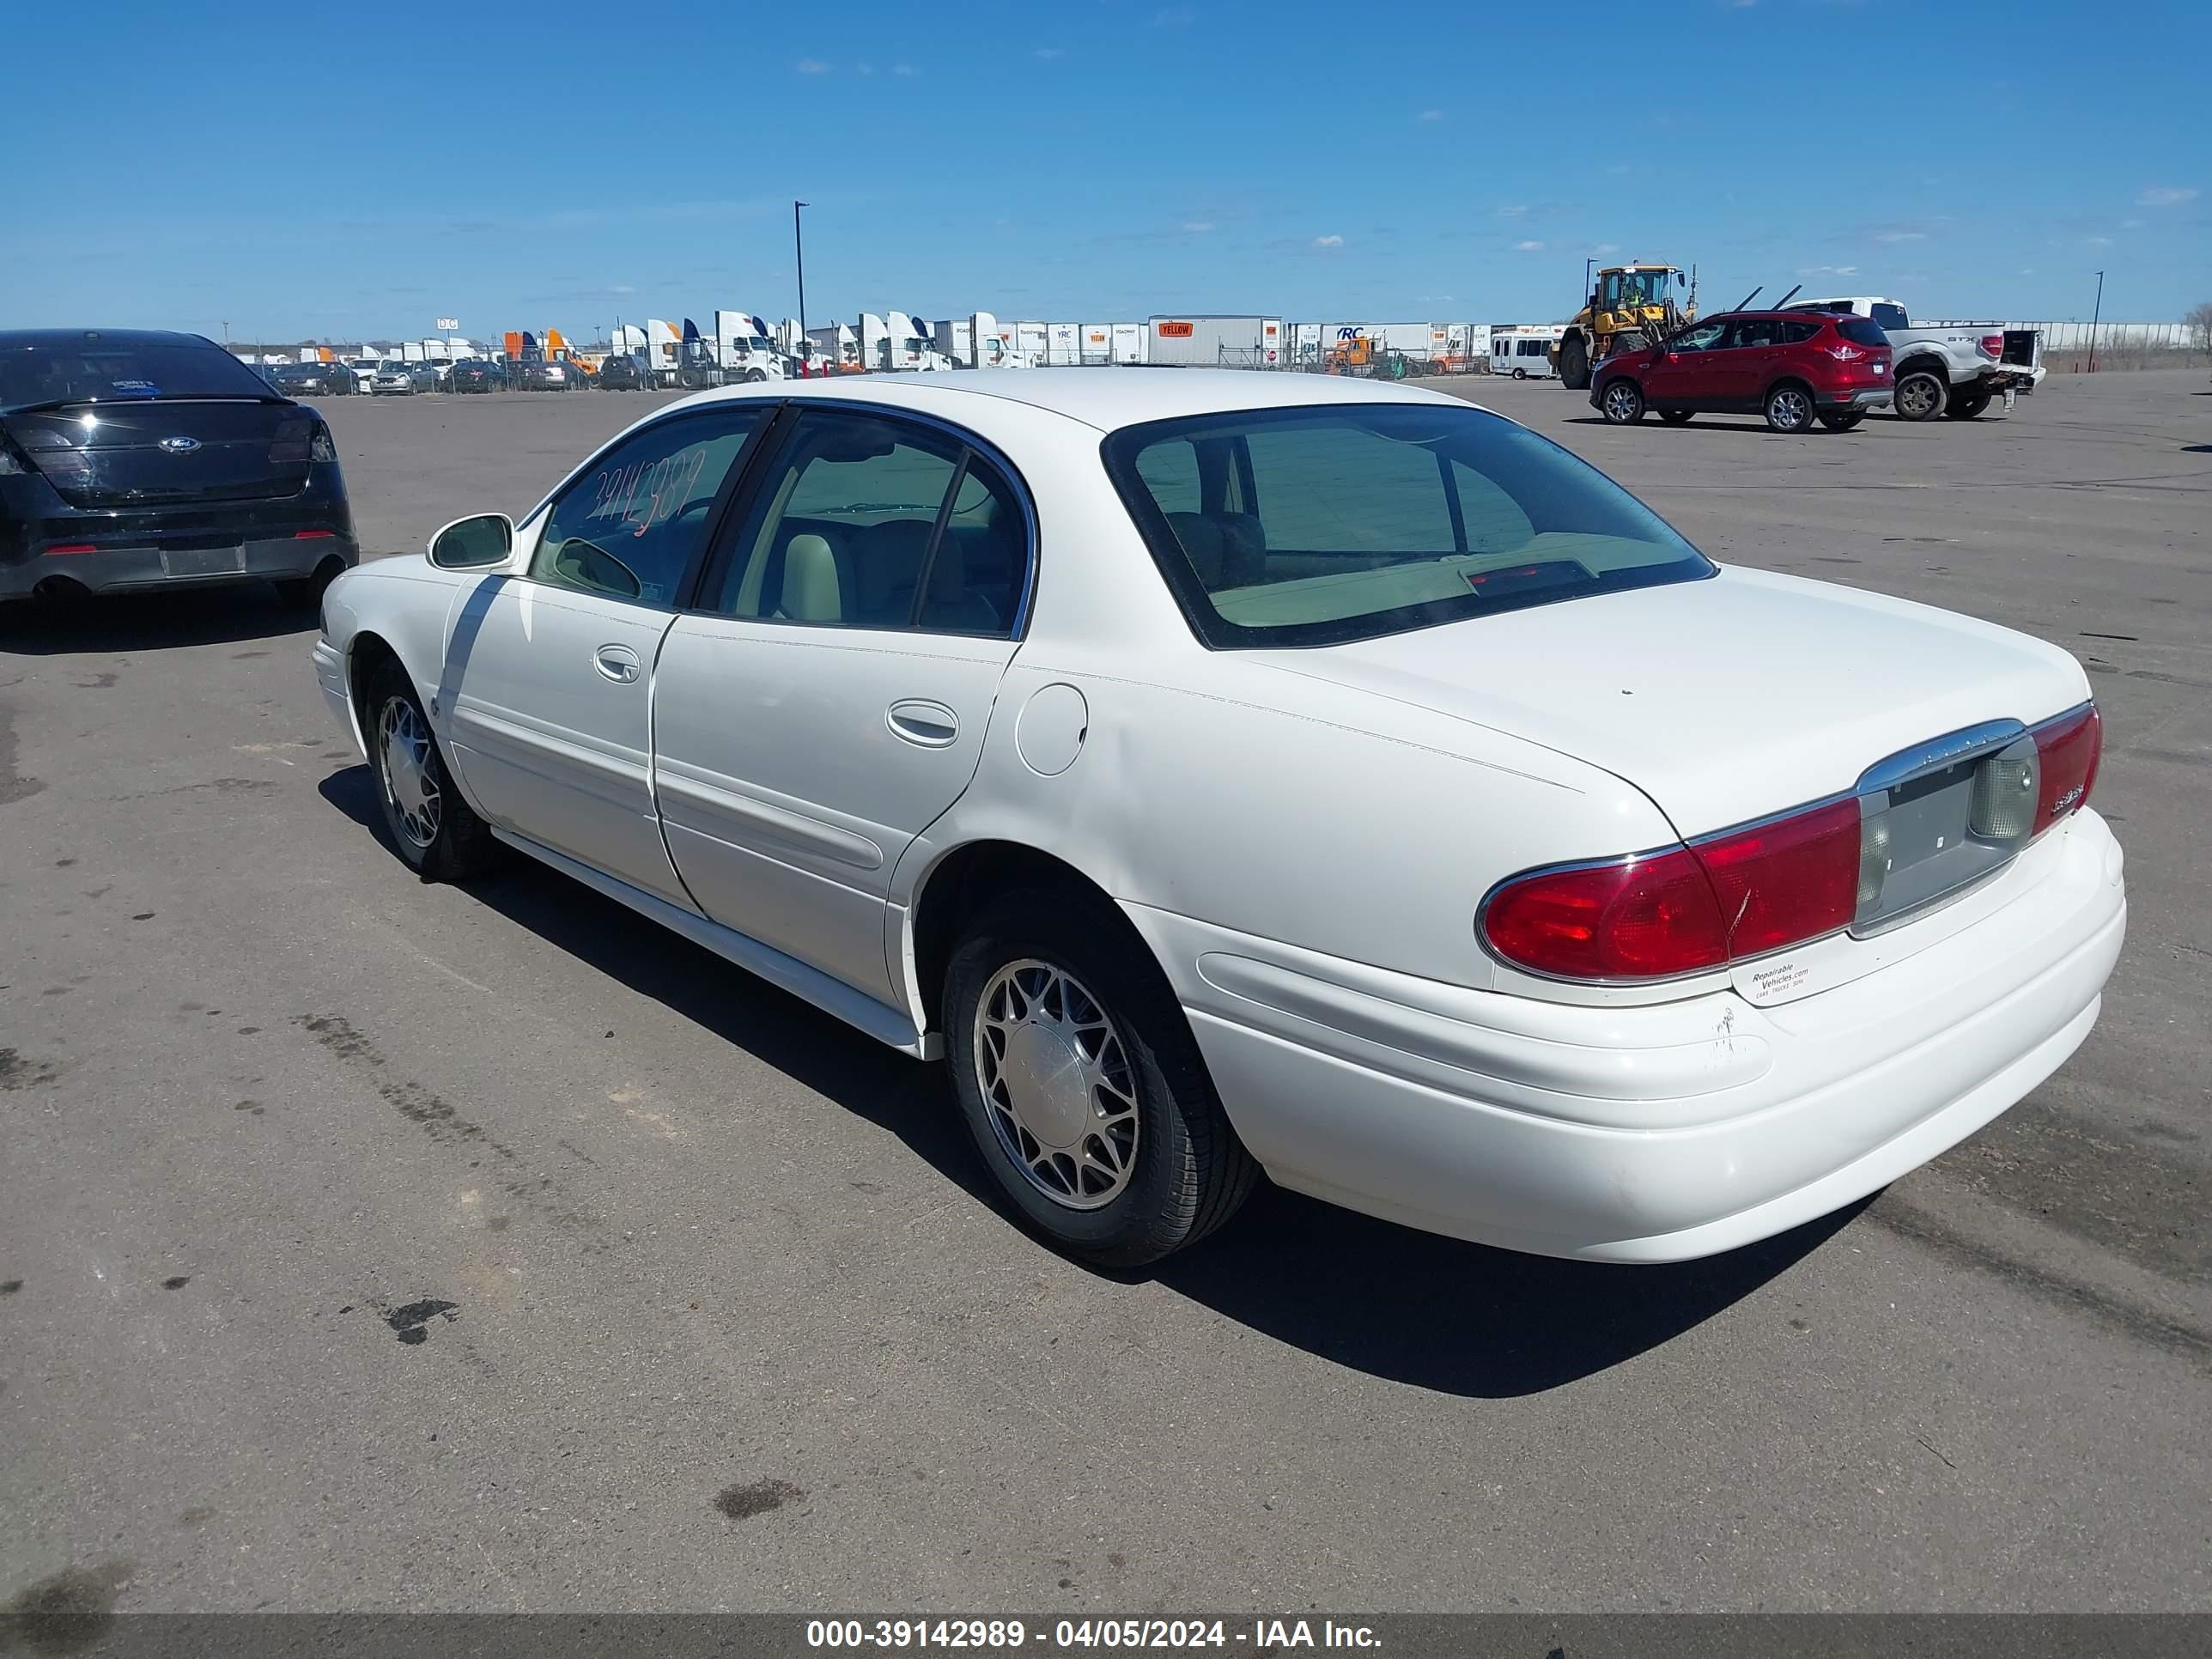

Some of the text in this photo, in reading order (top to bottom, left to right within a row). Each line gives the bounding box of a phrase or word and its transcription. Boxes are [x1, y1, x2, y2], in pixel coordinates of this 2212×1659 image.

[1163, 325, 1189, 335] YELLOW
[1337, 327, 1364, 340] YRC
[172, 439, 191, 447] Ford
[585, 450, 707, 538] 39142989
[1753, 963, 1794, 983] Repairable
[1762, 969, 1808, 990] Vehicles.com
